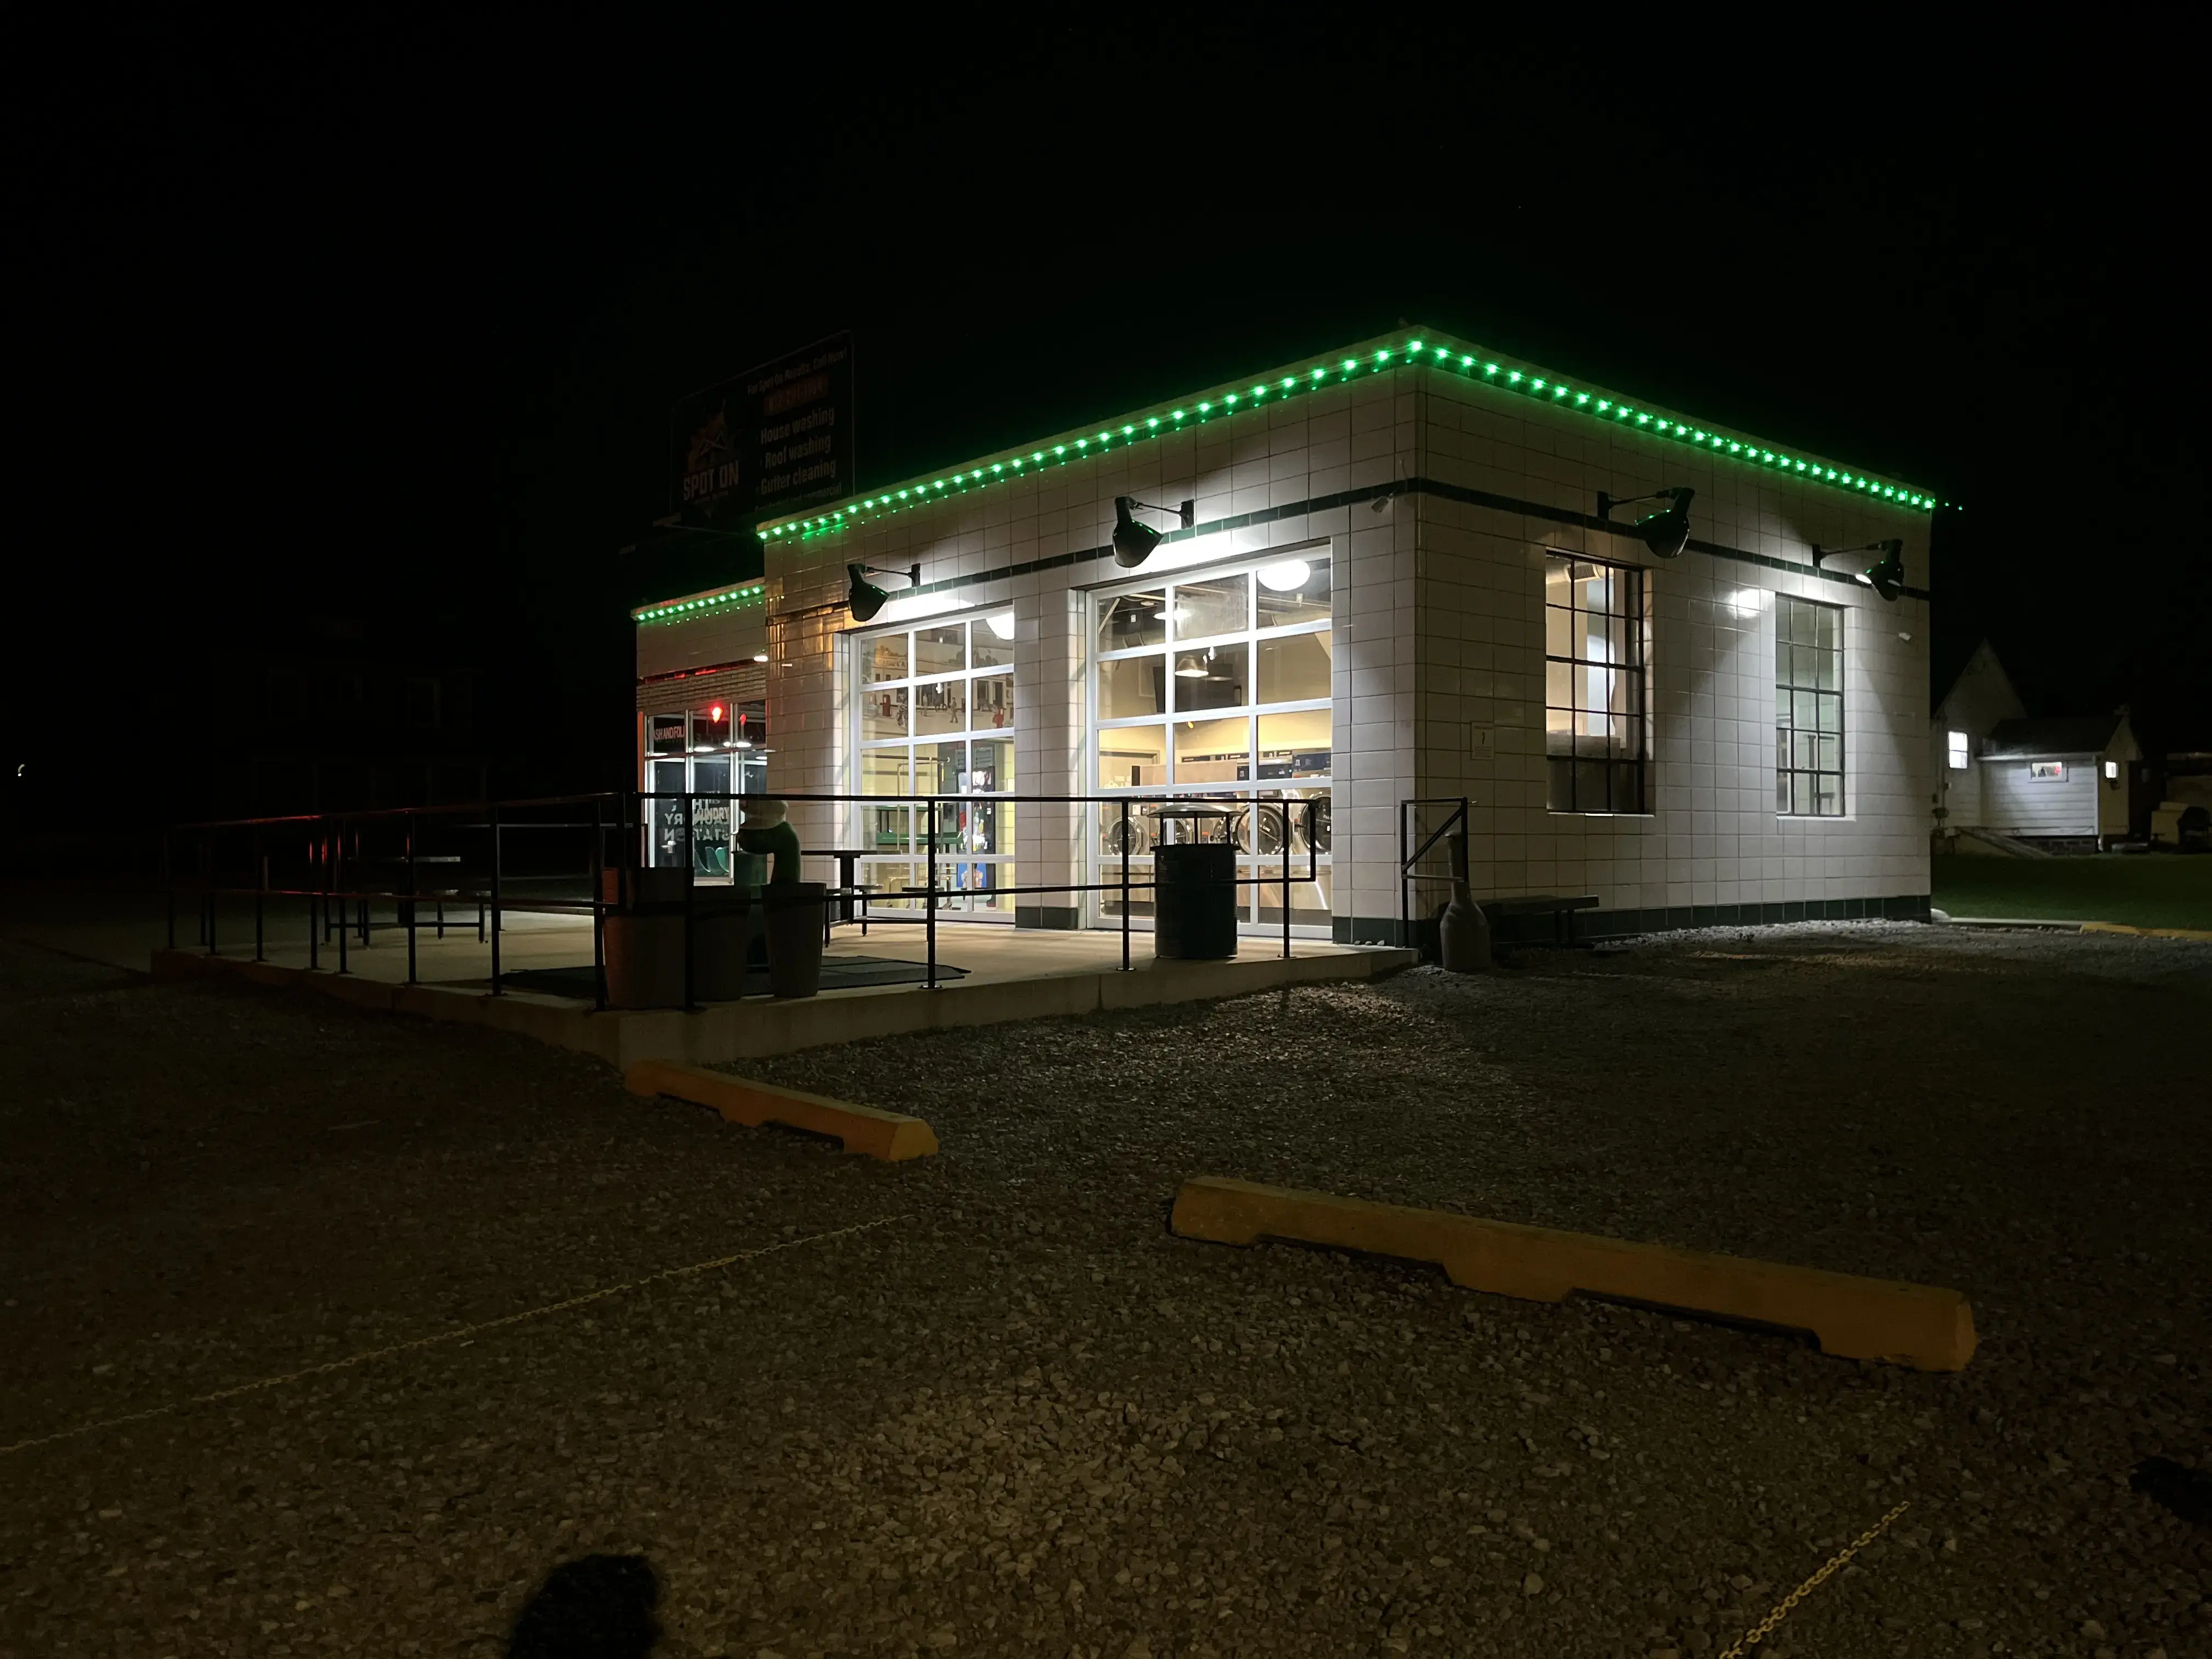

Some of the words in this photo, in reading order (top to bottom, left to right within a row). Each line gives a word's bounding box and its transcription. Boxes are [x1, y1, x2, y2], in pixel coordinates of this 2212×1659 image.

[775, 373, 783, 386] On
[760, 424, 791, 445] House
[792, 407, 835, 435] washing
[765, 445, 787, 469] Roof
[789, 435, 832, 461] washing
[684, 467, 715, 501] SPOT
[719, 460, 740, 488] ON
[761, 473, 791, 495] Gutter
[793, 460, 836, 486] cleaning
